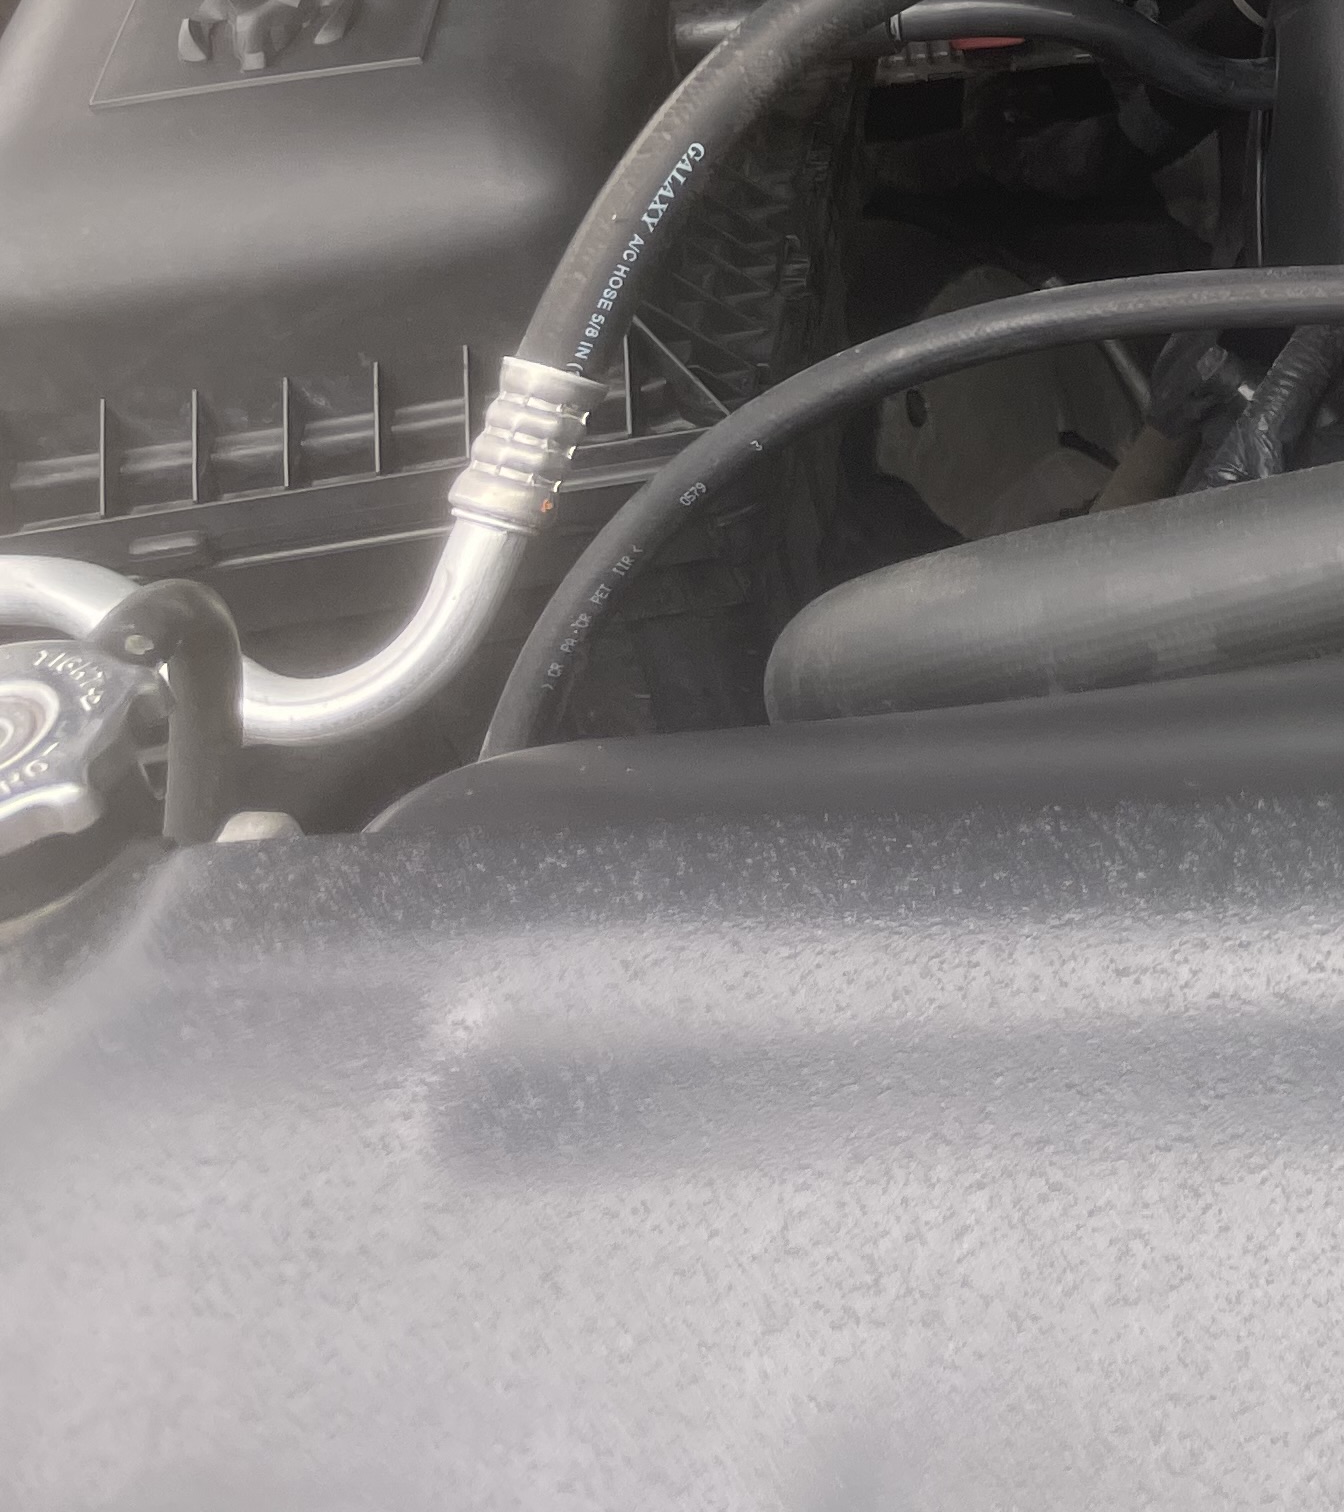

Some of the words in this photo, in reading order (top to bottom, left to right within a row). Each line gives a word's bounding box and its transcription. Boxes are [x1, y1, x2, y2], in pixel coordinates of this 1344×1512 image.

[640, 141, 705, 234] GALAXY
[622, 233, 645, 263] A/C
[596, 263, 630, 312] HOSE
[585, 314, 605, 340] 5/8
[574, 340, 590, 360] IN
[679, 481, 707, 508] 0579
[547, 662, 564, 678] CR
[589, 583, 613, 606] PET
